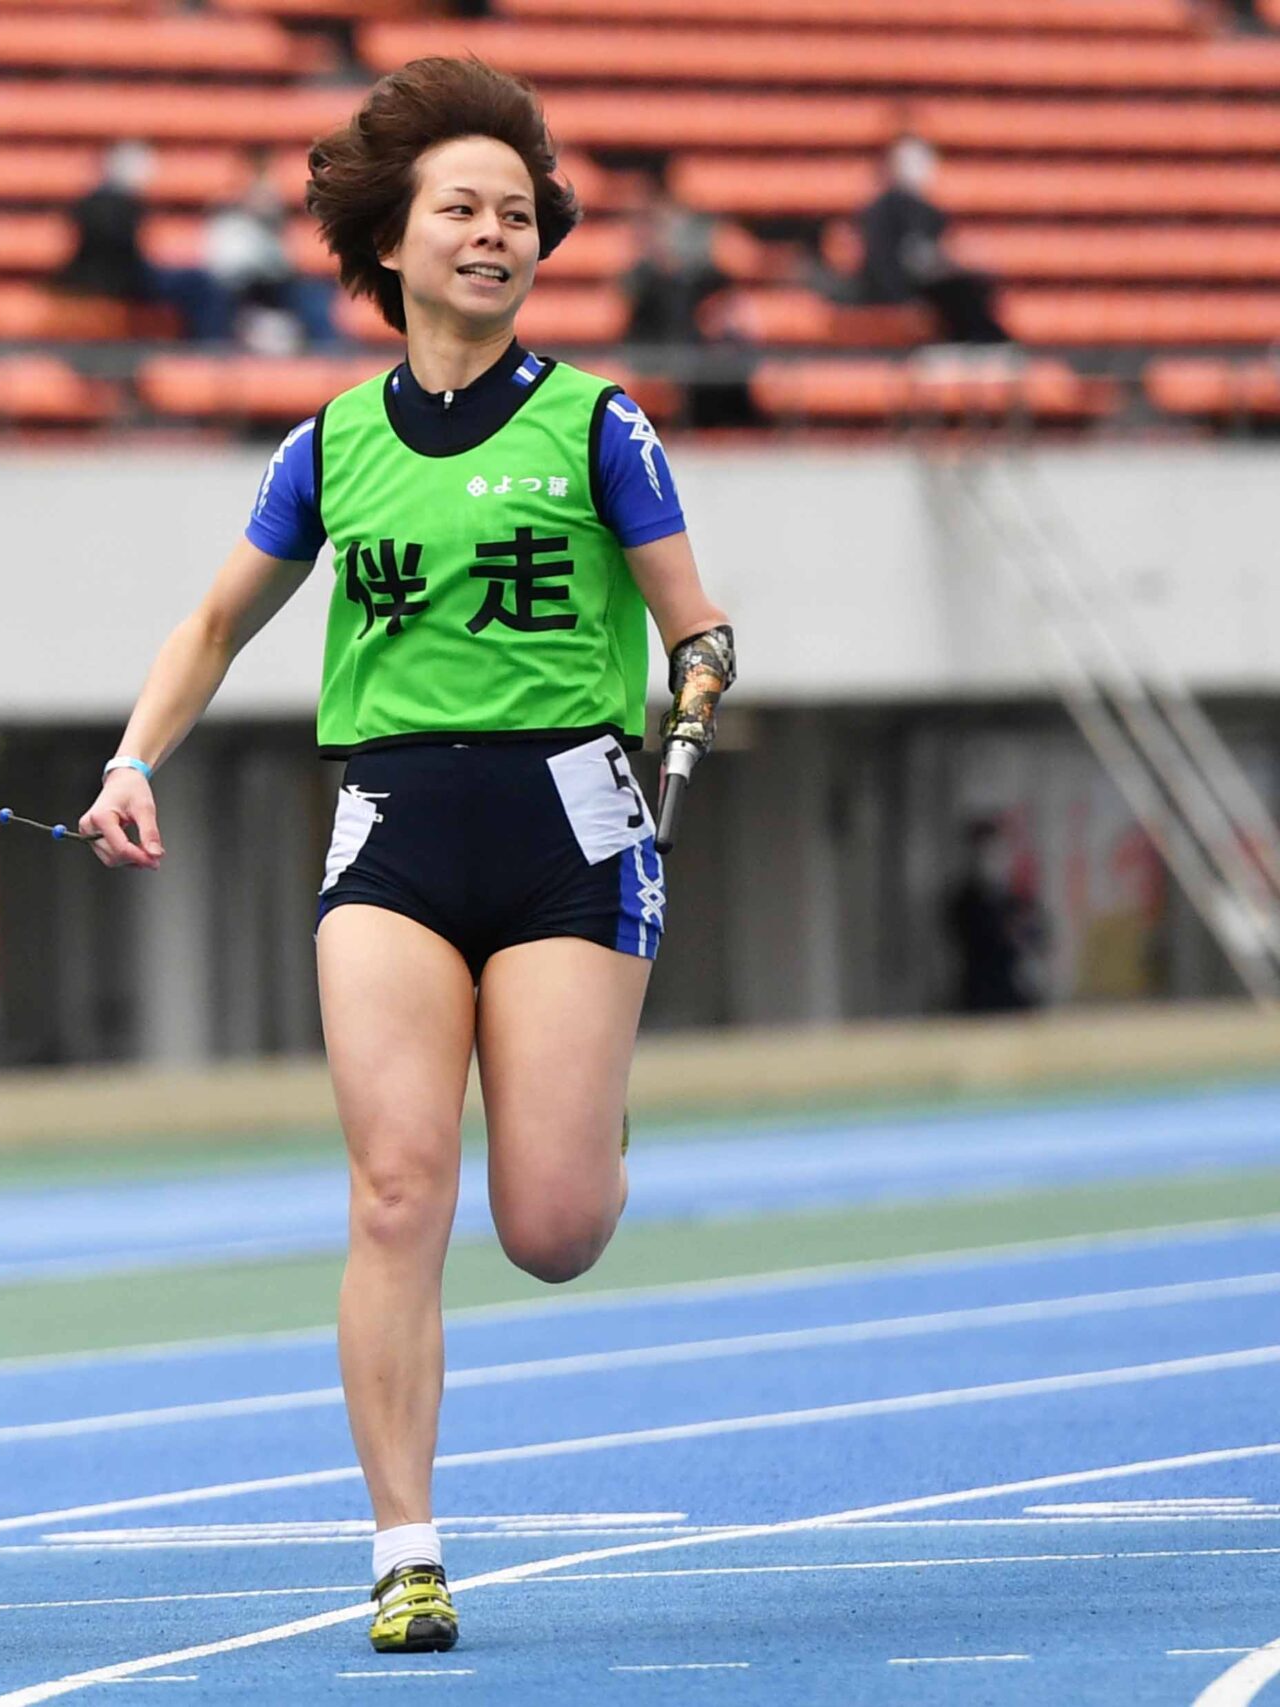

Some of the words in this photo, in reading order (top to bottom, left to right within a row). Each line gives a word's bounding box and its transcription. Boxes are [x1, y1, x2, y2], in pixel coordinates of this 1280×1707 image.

[493, 475, 569, 497] よつ葉
[346, 526, 579, 640] 伴走
[604, 746, 645, 829] 5
